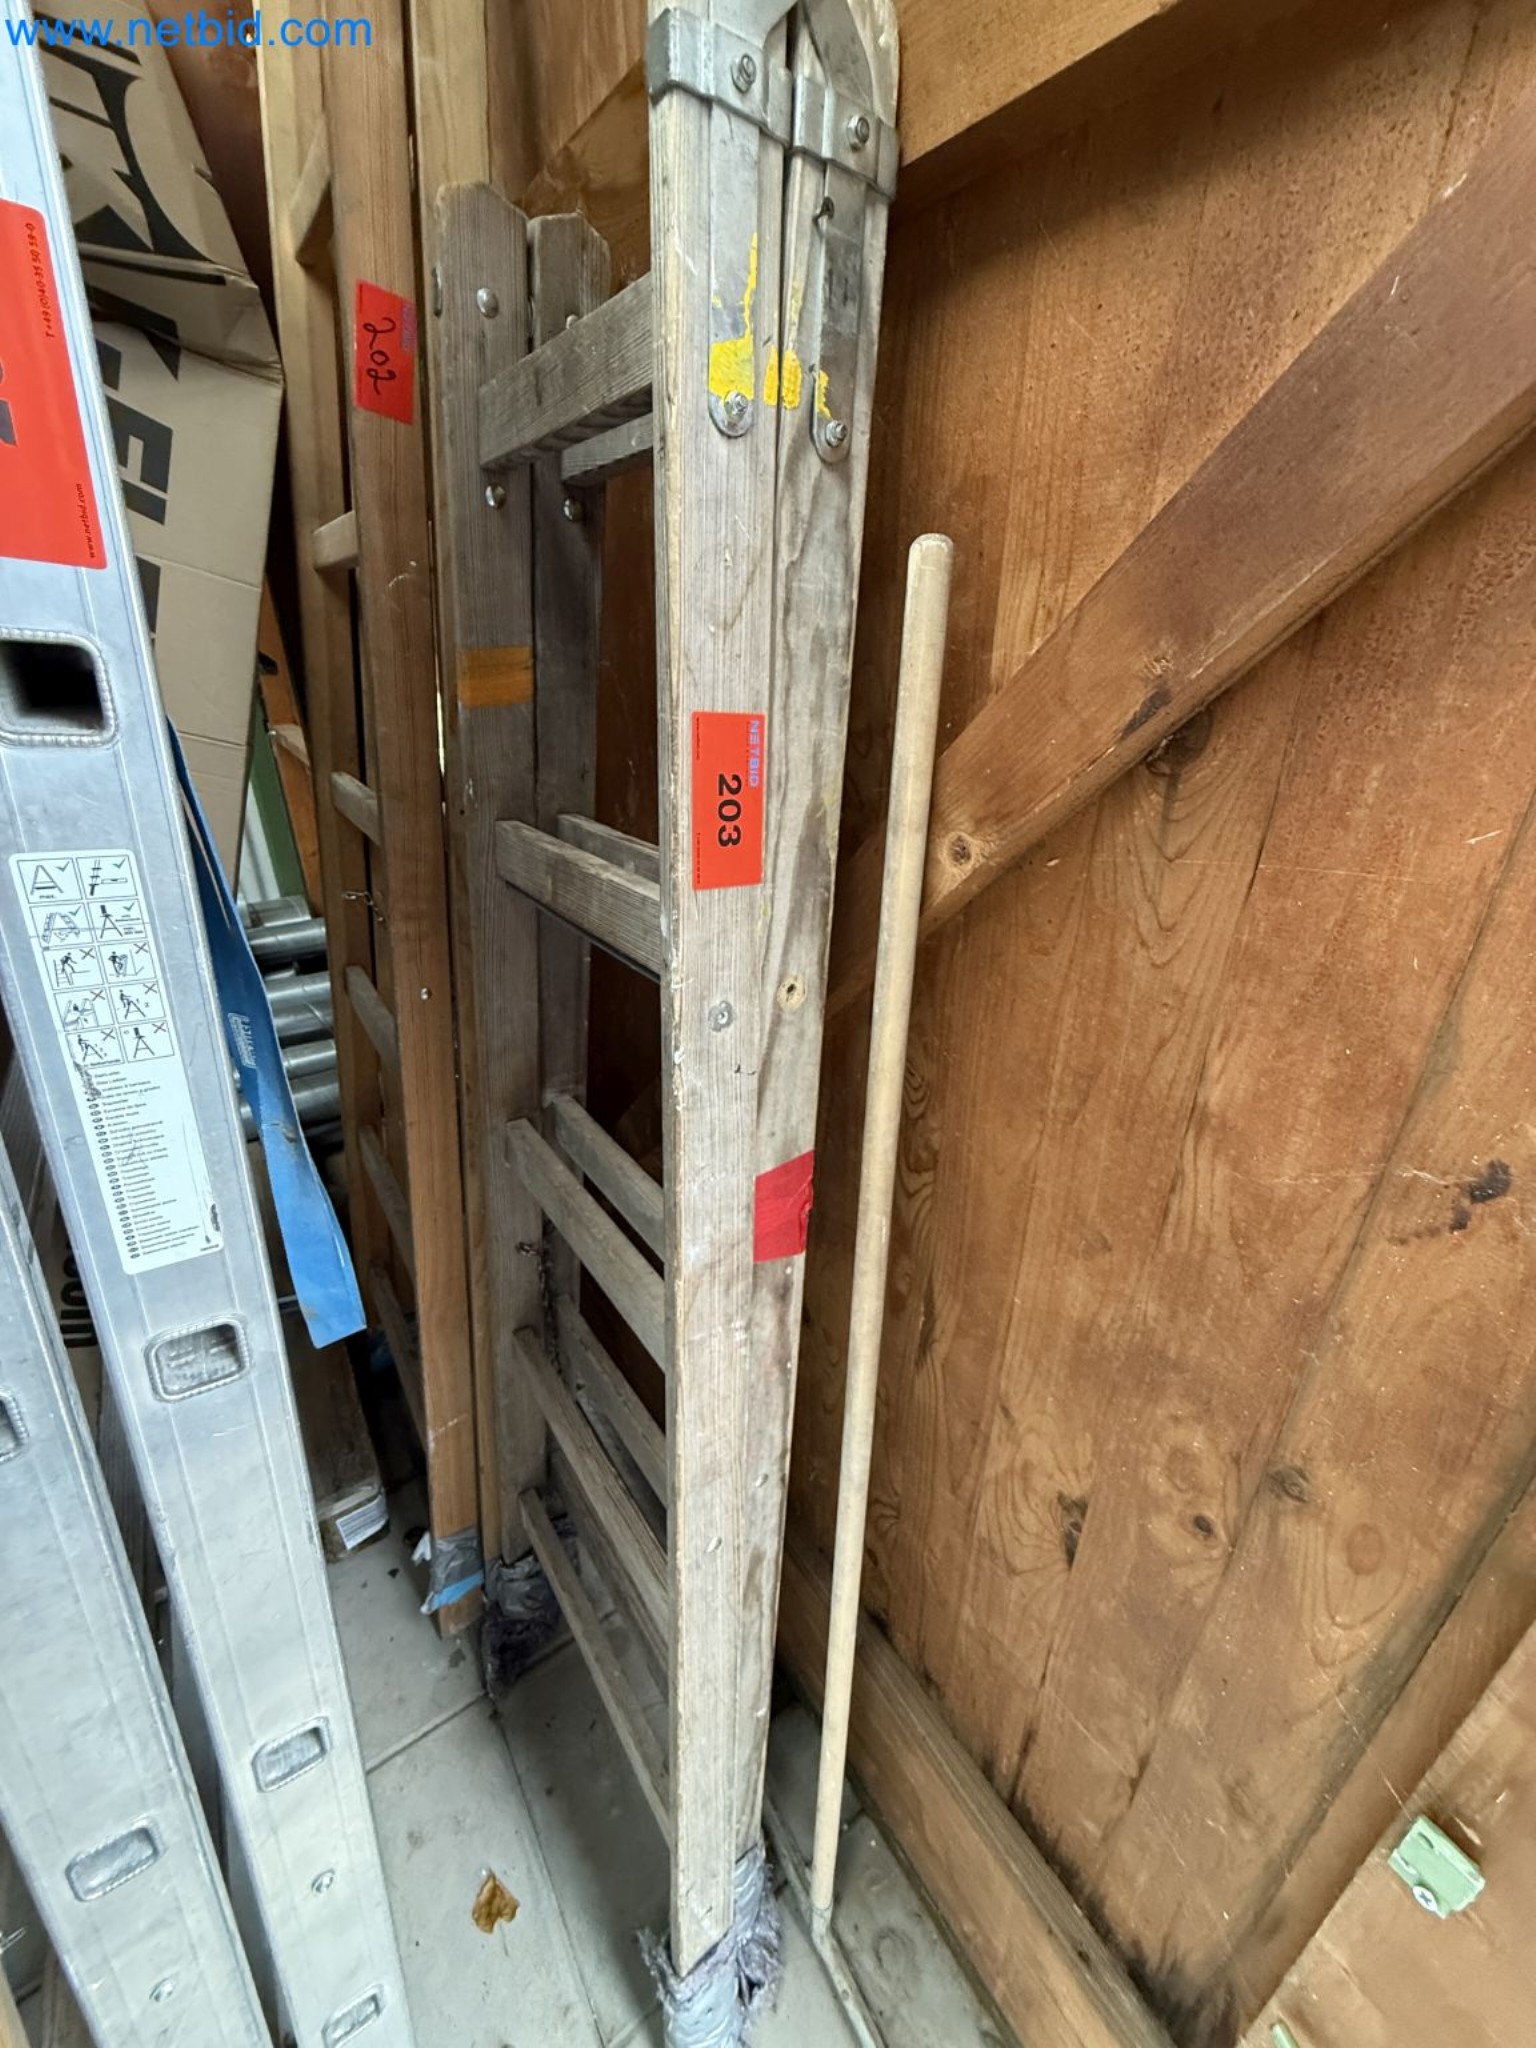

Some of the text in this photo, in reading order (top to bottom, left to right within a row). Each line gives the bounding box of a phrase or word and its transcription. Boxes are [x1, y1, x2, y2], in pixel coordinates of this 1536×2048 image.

[363, 317, 397, 395] 202
[76, 483, 96, 558] www.netbid.com
[749, 719, 760, 788] NETBID
[718, 773, 742, 847] 203
